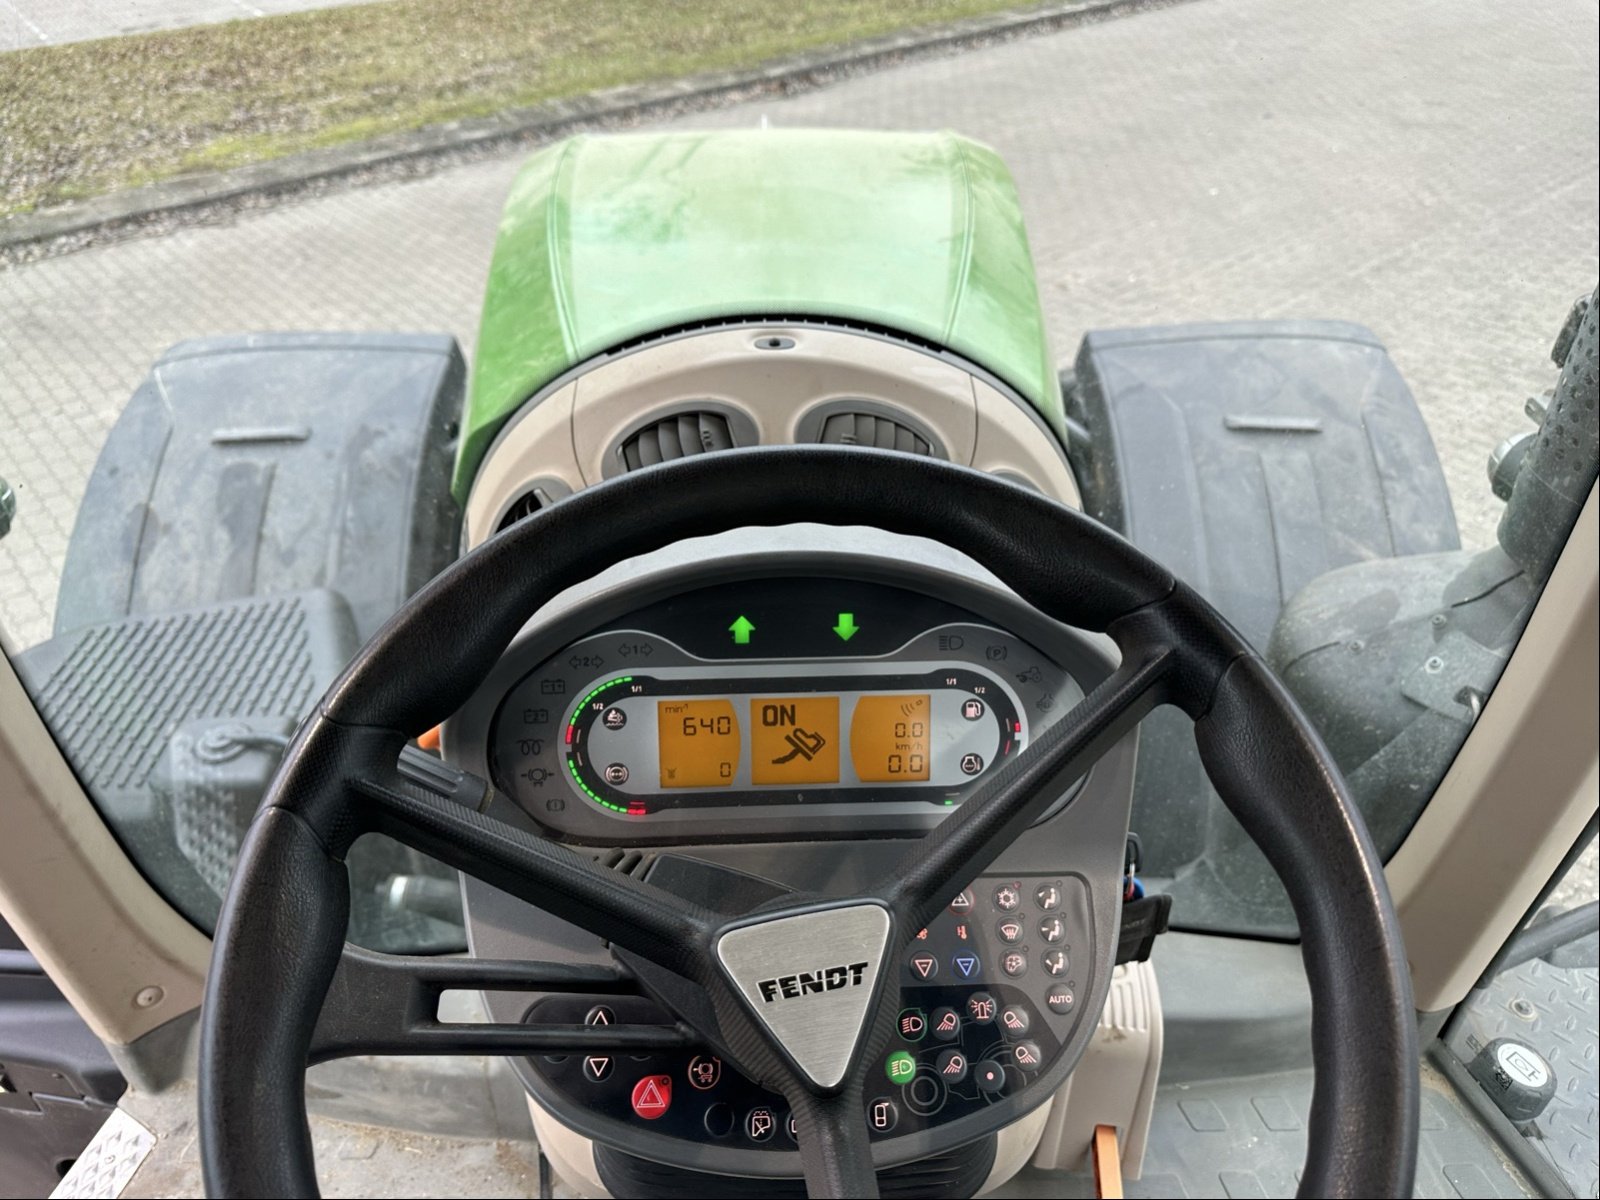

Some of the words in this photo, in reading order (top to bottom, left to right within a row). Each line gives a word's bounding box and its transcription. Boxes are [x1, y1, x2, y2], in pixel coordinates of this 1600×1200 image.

[945, 677, 957, 686] 1/1
[630, 685, 643, 693] 1/1
[973, 686, 986, 695] 1/2
[592, 702, 605, 711] 1/2
[762, 704, 796, 727] ON
[682, 716, 731, 736] 640
[894, 722, 924, 738] 0.0
[895, 742, 924, 751] km/h
[719, 762, 732, 778] 0
[888, 754, 924, 774] 0.0
[756, 961, 869, 1003] FENDT
[1048, 994, 1073, 1004] AUTO
